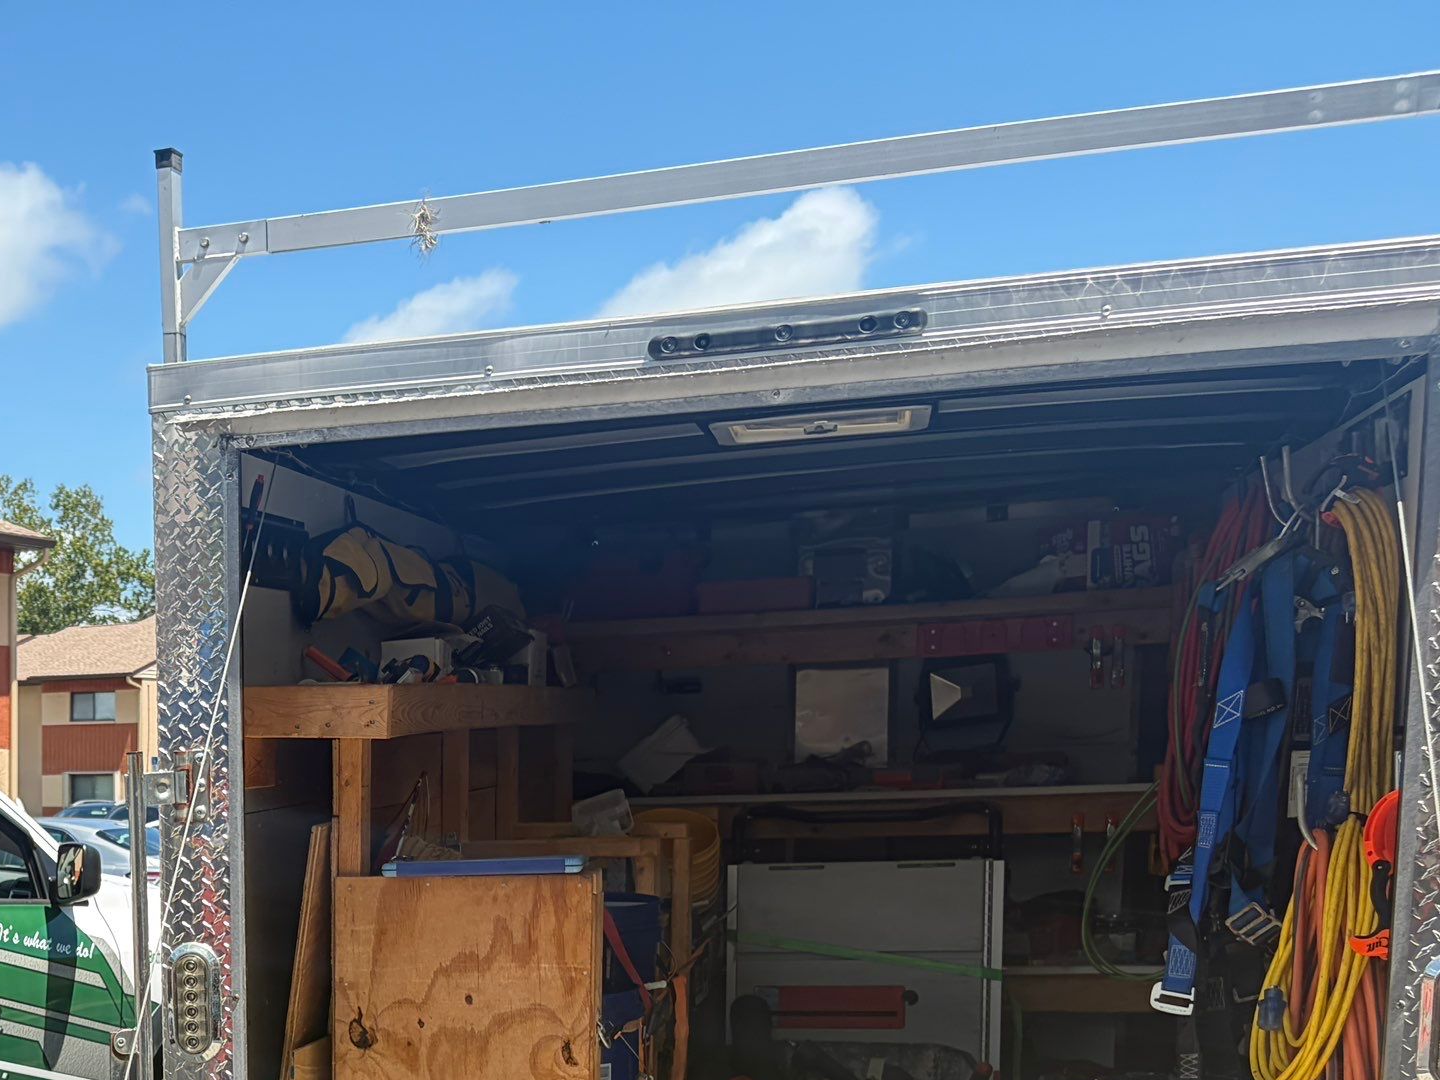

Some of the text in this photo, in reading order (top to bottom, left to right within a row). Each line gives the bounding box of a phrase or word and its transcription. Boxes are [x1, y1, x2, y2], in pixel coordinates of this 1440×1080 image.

[1130, 525, 1152, 583] AGS
[23, 932, 52, 951] what
[55, 941, 71, 955] we
[76, 942, 95, 959] do!
